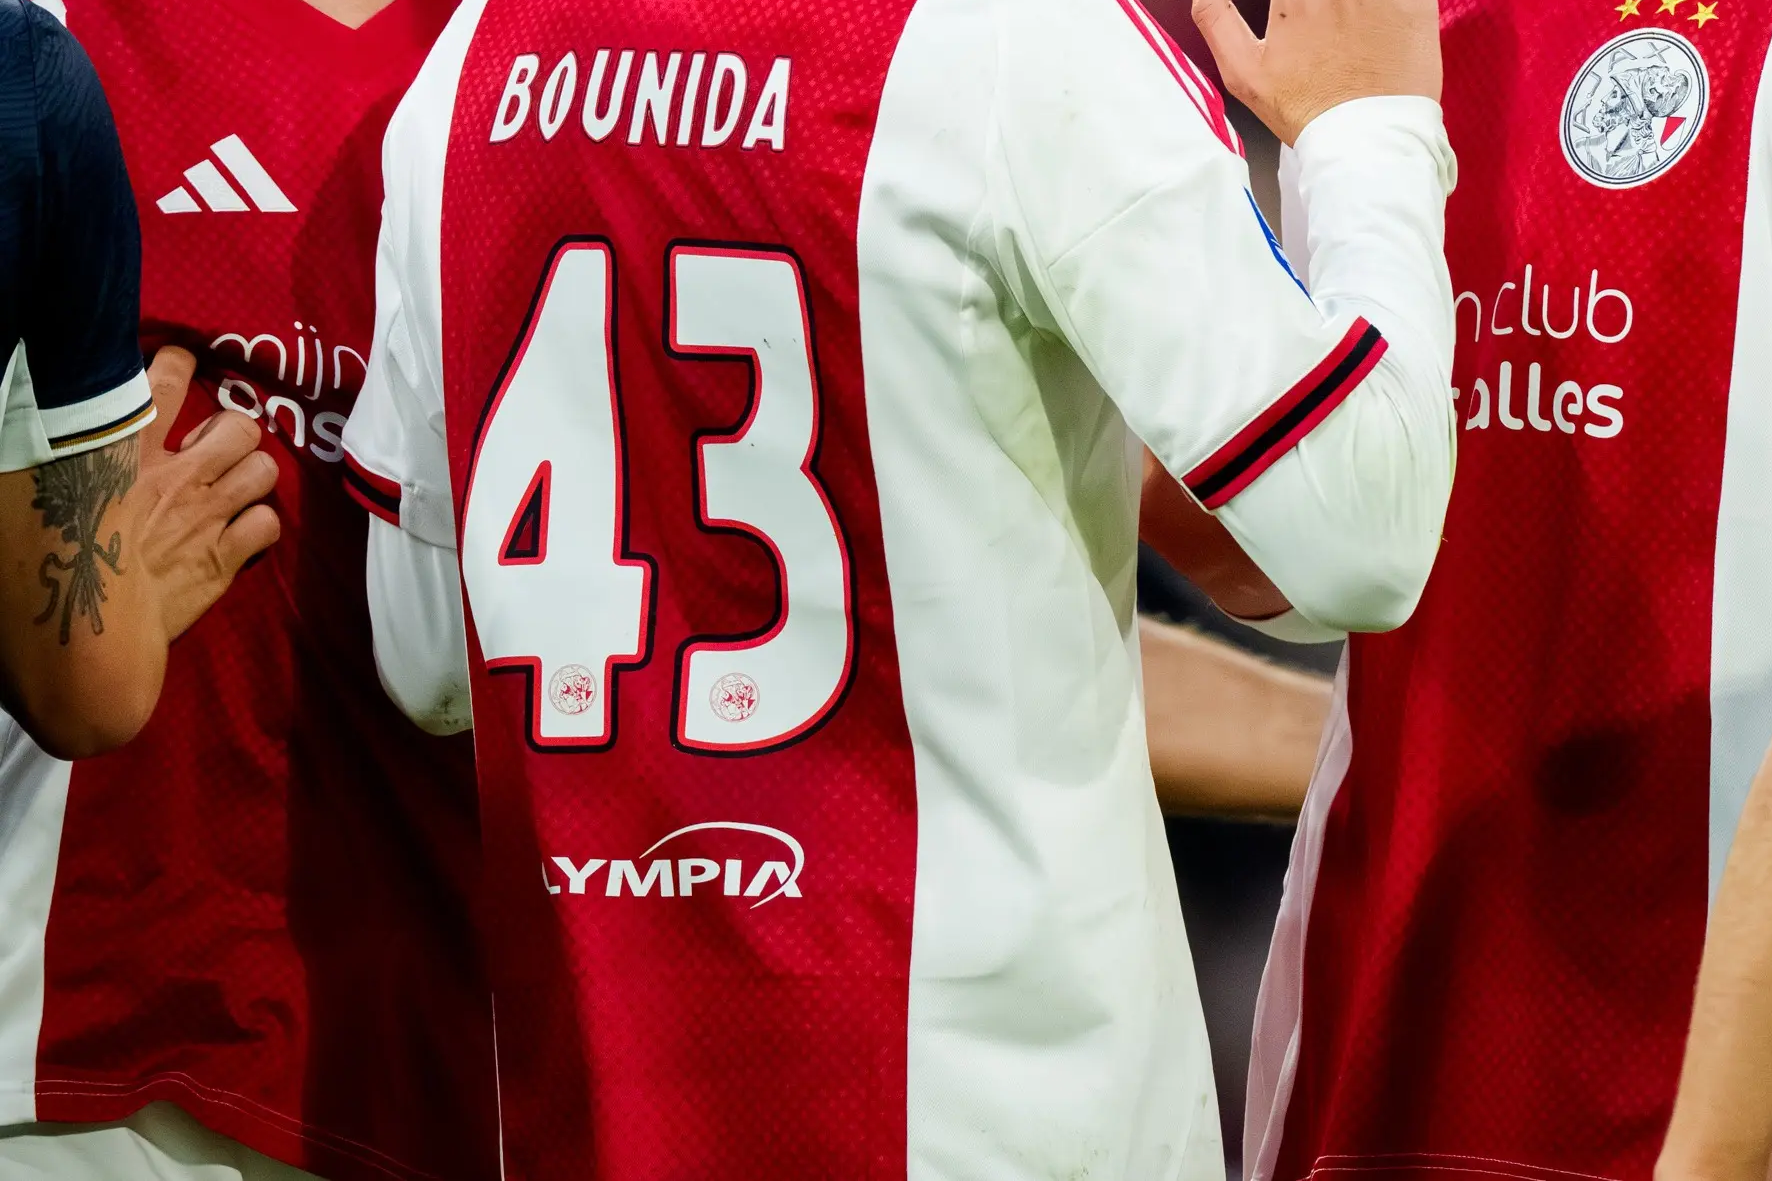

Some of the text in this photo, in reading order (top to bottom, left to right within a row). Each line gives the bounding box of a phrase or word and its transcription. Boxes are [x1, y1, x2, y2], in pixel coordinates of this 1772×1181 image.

[490, 49, 792, 151] BOUNIDA
[1572, 40, 1672, 135] AJAX
[217, 377, 348, 463] ons
[461, 236, 858, 757] 43
[541, 851, 806, 910] LYMPIA
